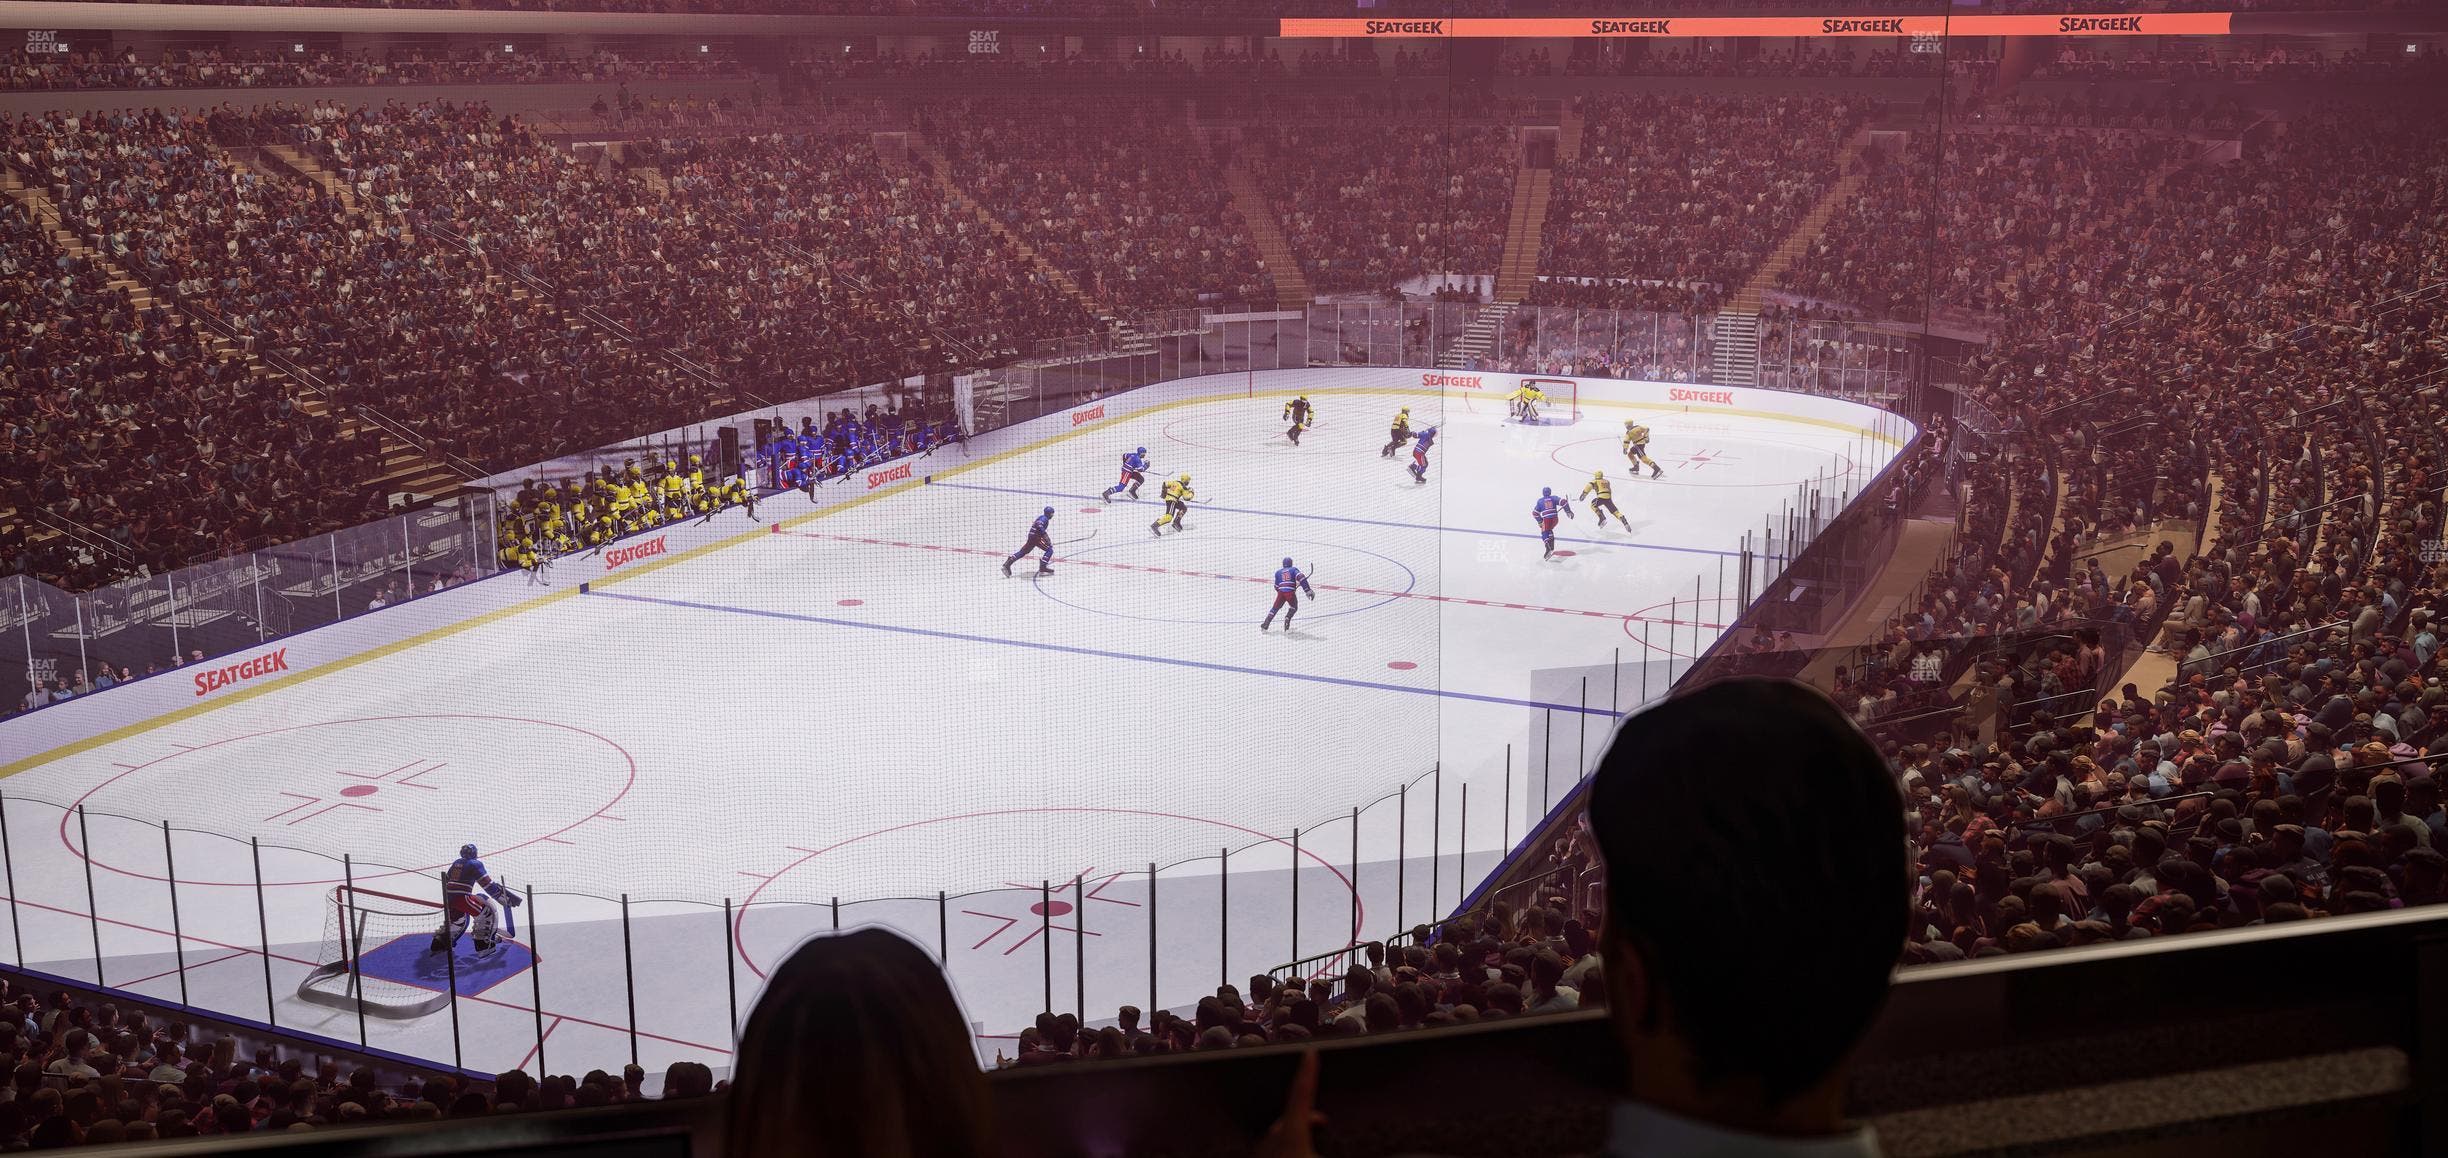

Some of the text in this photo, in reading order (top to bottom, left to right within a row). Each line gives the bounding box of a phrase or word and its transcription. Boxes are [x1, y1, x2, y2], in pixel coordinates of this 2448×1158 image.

[1366, 20, 1443, 34] SEATGEEK
[1591, 20, 1670, 34] SEATGEEK
[1822, 19, 1904, 33] SEATGEEK
[2059, 17, 2142, 32] SEATGEEK
[1422, 373, 1482, 388] SEATGEEK
[1669, 388, 1733, 405] SEATGEEK
[1072, 404, 1105, 427] SEATGEEK
[867, 462, 912, 490] SEATGEEK
[605, 535, 667, 570] SEATGEEK
[194, 647, 288, 696] SEATGEEK
